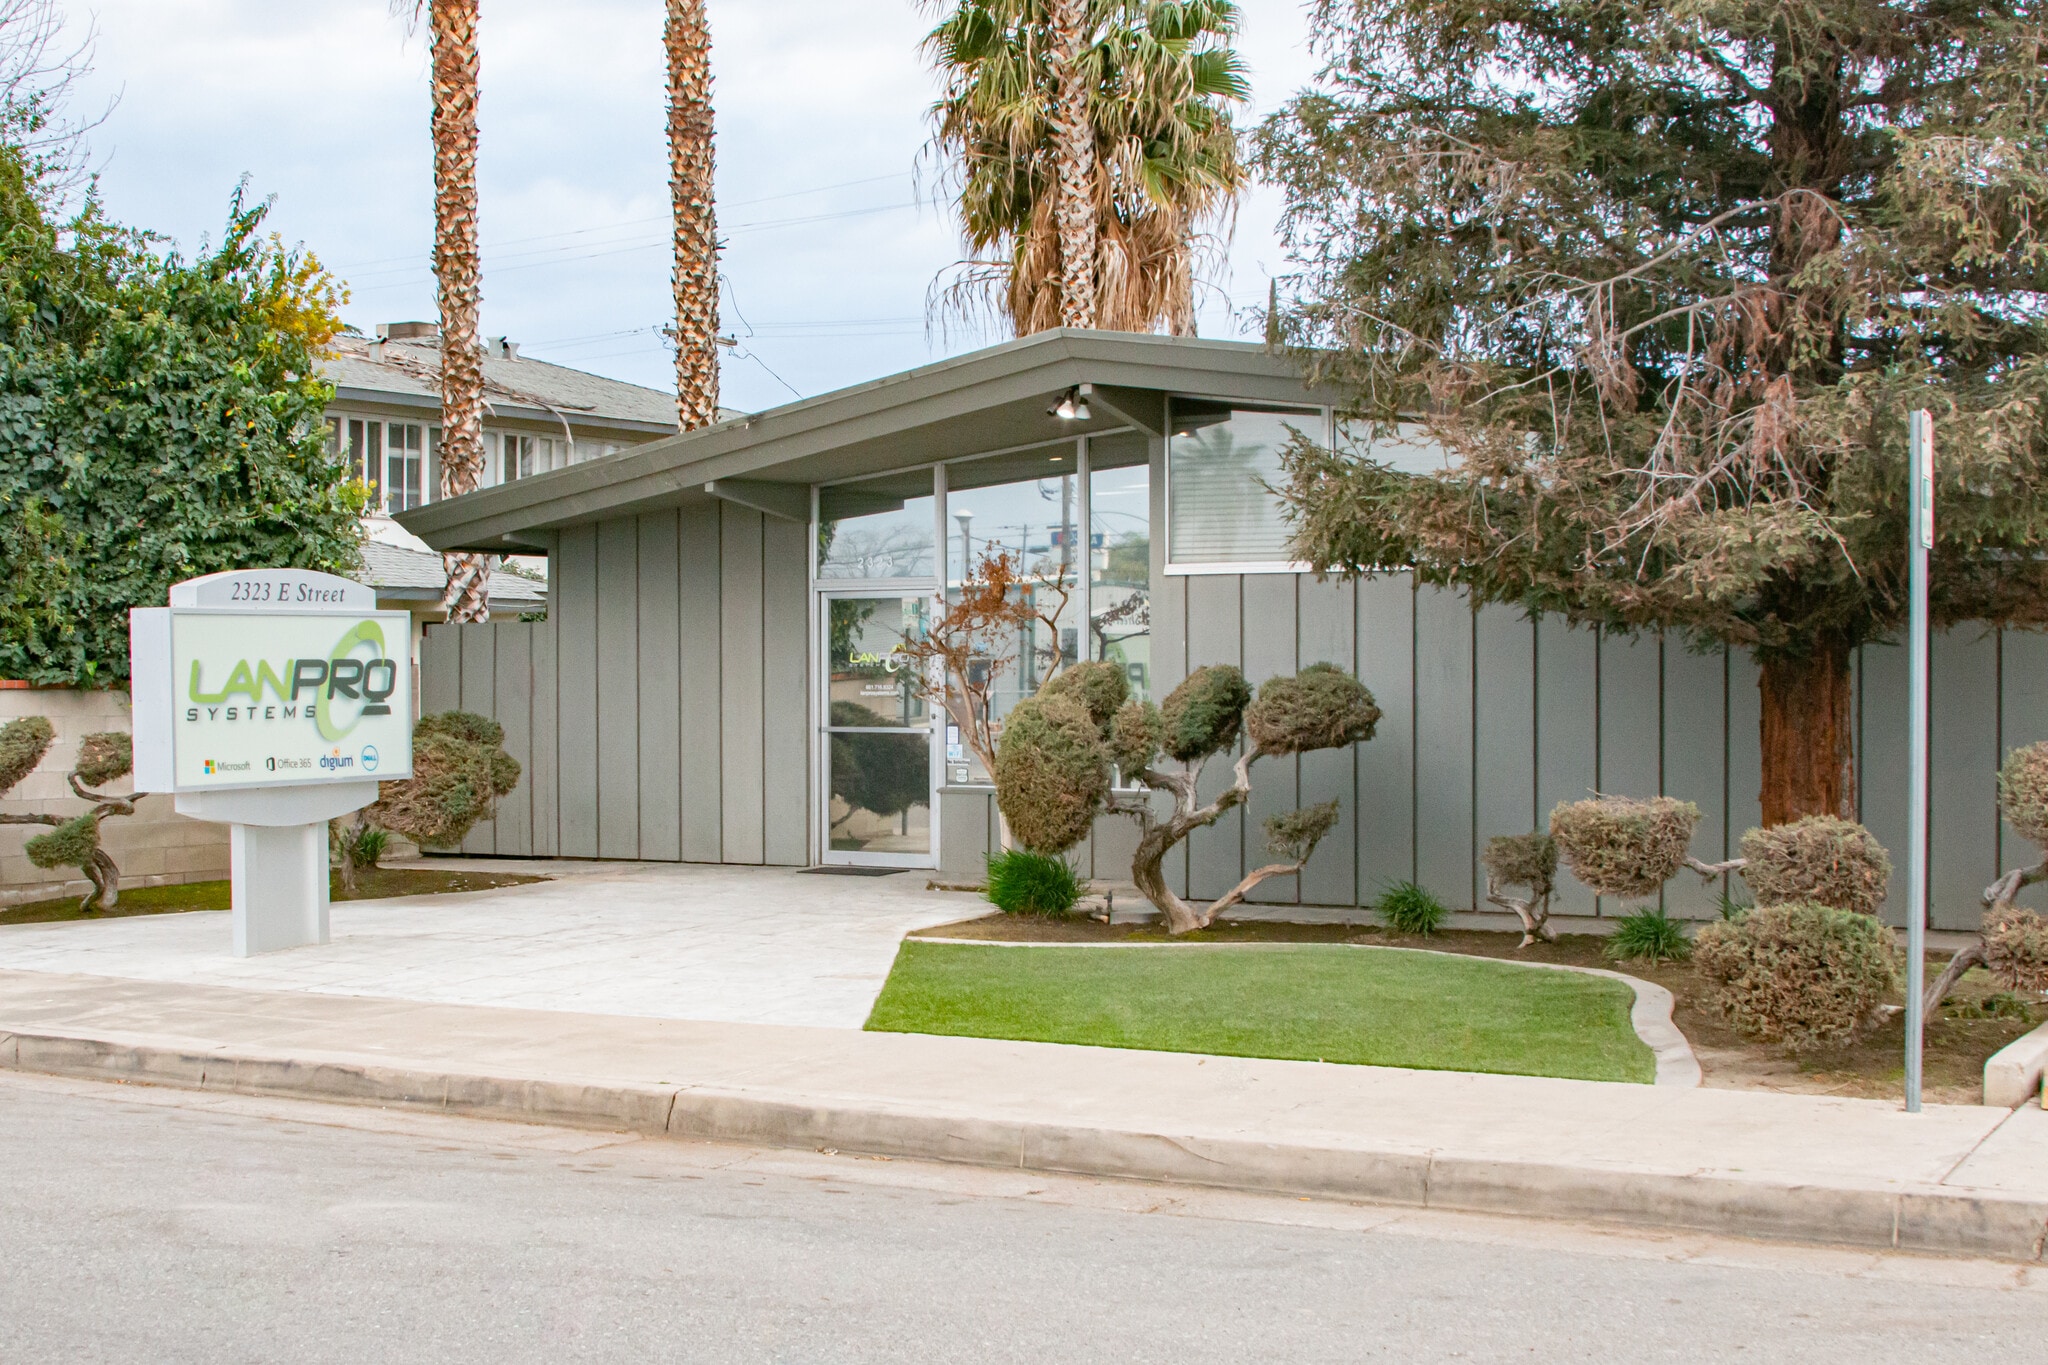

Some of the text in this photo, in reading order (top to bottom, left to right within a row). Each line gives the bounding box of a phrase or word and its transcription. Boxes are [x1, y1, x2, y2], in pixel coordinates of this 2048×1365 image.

[857, 556, 893, 568] 2323
[231, 582, 345, 603] 2323 E Street
[189, 658, 397, 703] LANPRO
[186, 705, 317, 722] SYSTEMS
[217, 761, 251, 771] Microsoft
[278, 758, 312, 769] Office 365
[320, 749, 354, 771] digium
